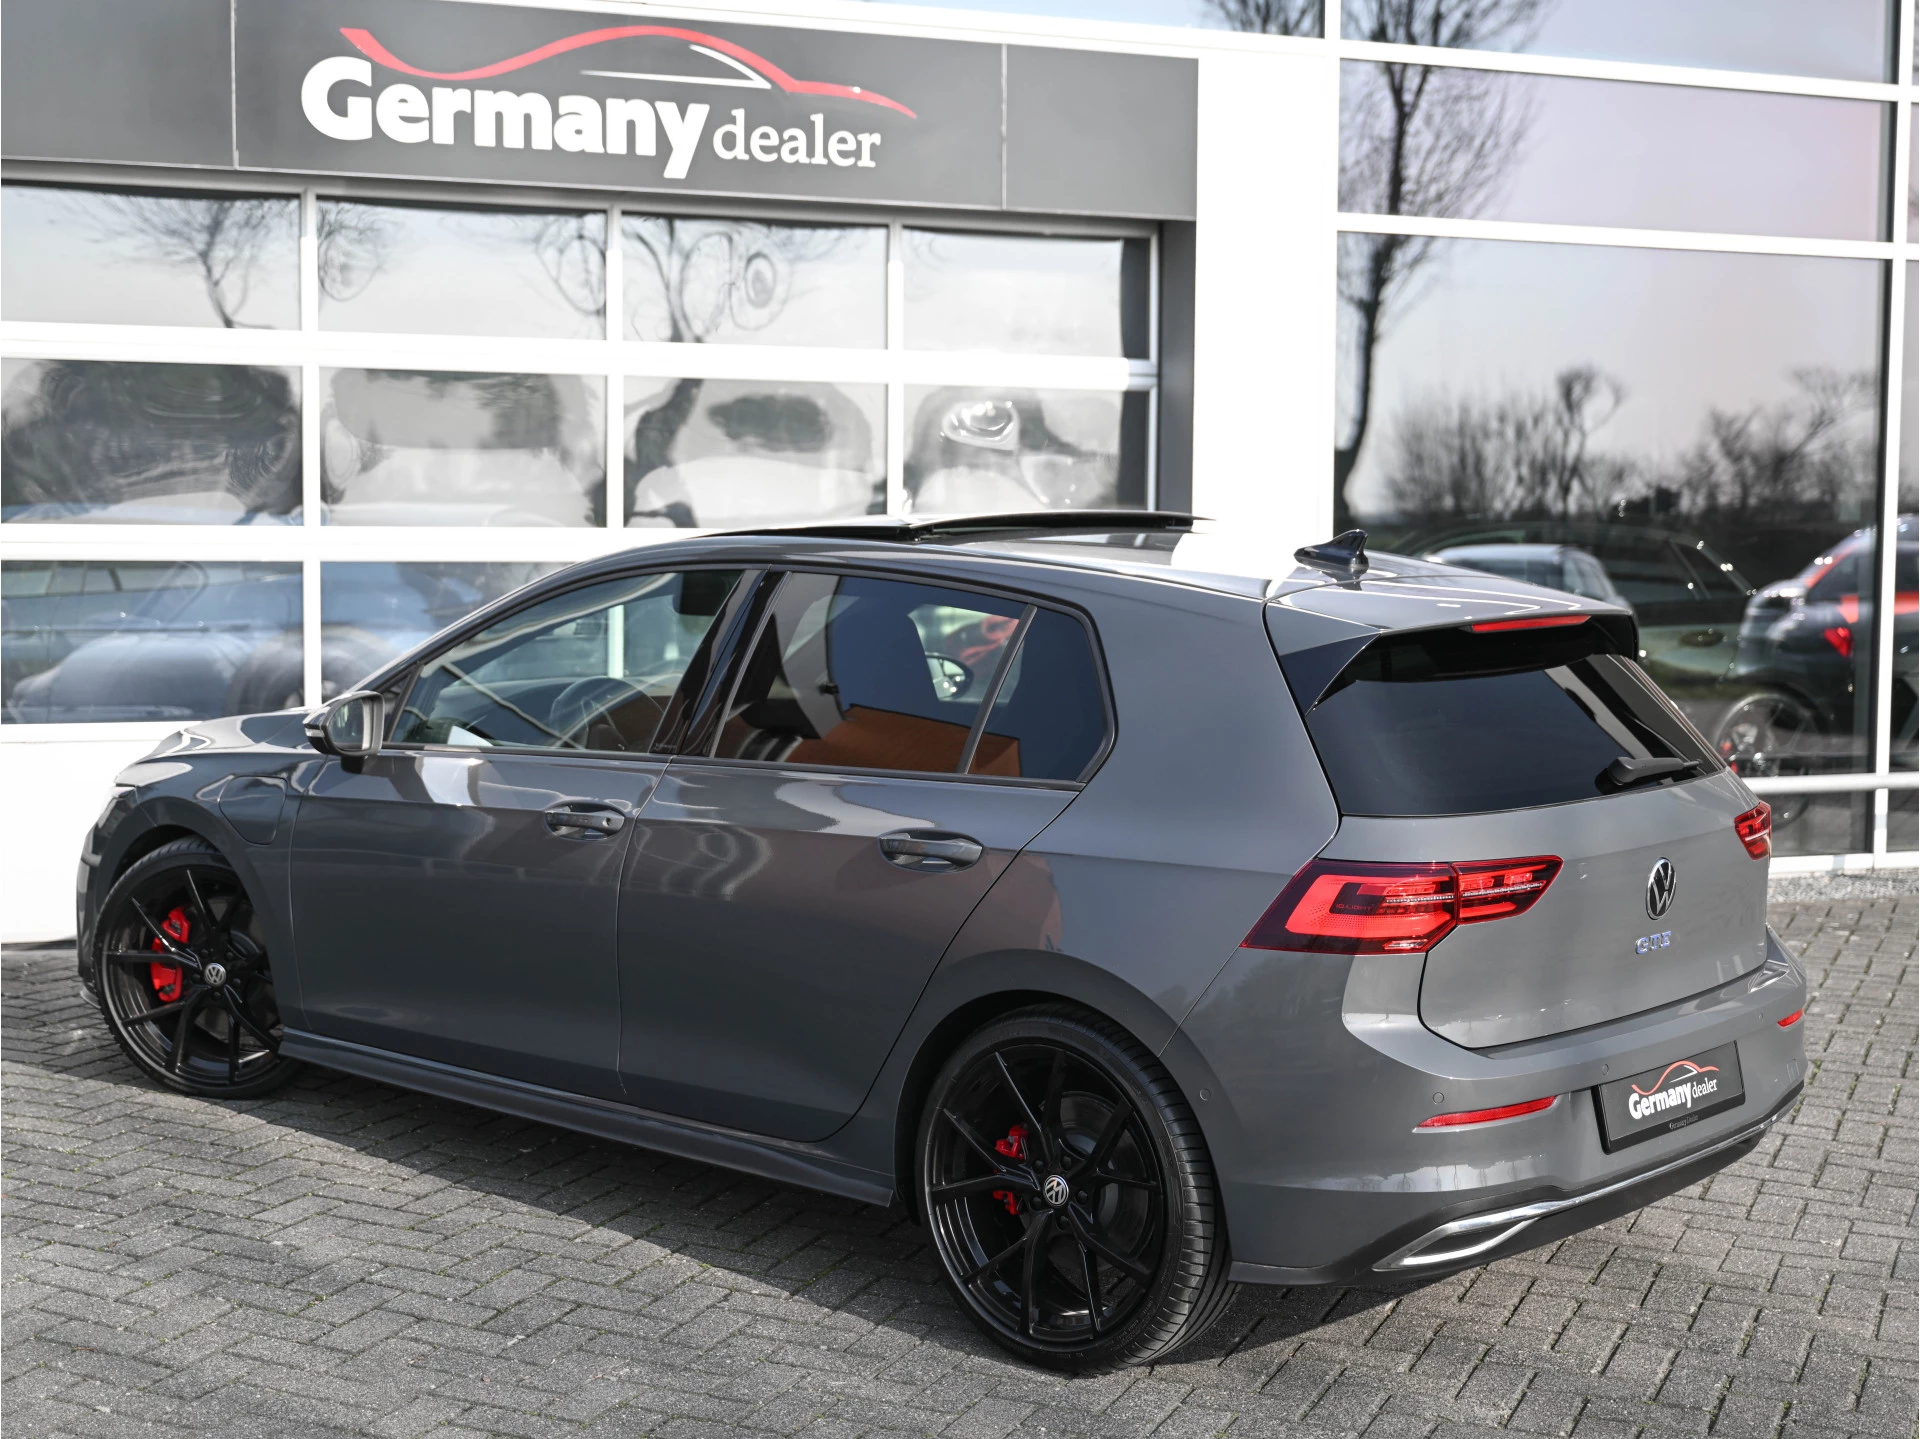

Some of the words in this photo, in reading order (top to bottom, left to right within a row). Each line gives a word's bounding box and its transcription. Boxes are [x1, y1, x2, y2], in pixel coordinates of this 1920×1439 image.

[301, 56, 709, 178] Germany
[713, 108, 881, 168] dealer
[1635, 931, 1671, 954] GTE
[1628, 1082, 1692, 1120] Germany
[1692, 1077, 1717, 1098] dealer
